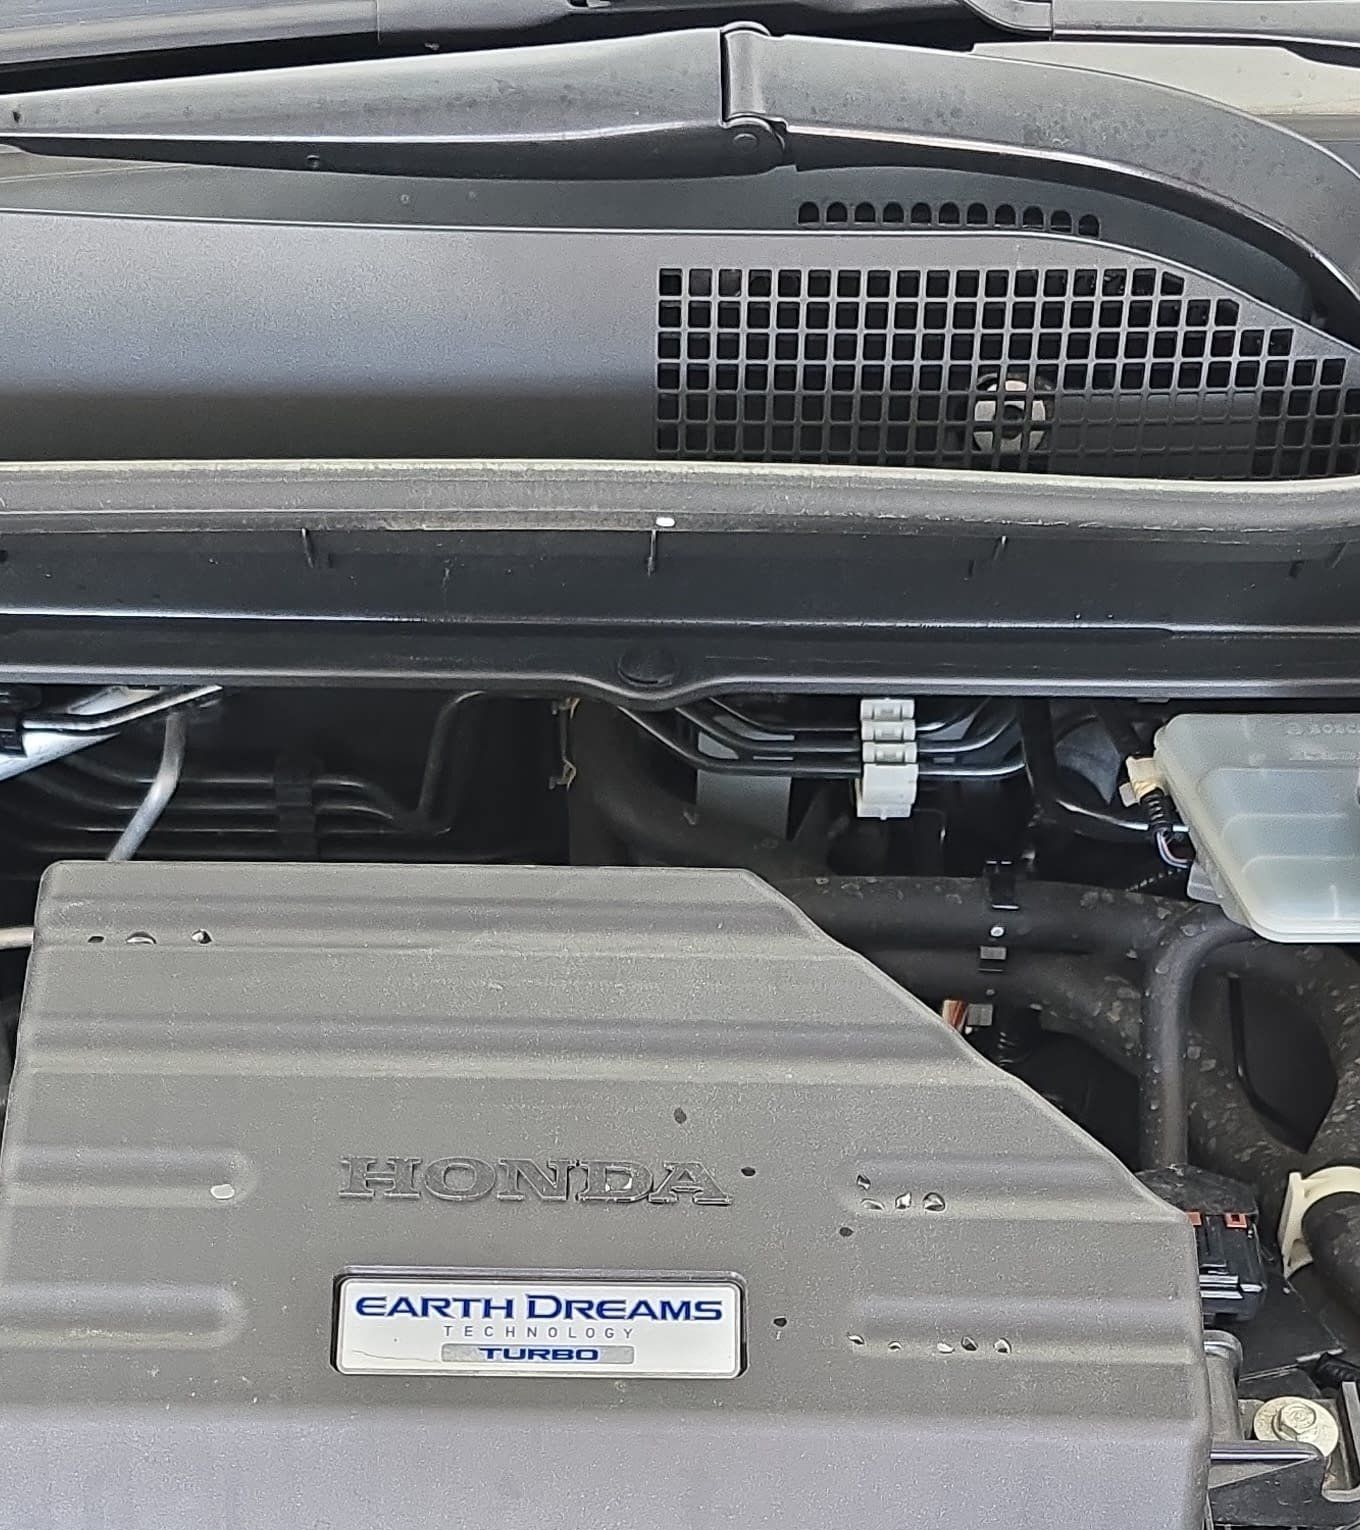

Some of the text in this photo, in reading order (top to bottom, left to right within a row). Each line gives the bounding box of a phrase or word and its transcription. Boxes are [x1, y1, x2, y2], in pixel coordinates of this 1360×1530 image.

[339, 1156, 734, 1207] HONDA
[355, 1292, 723, 1322] EARTH DREAMS
[443, 1325, 634, 1339] TECHNOLOGY
[477, 1346, 600, 1362] TURBO
